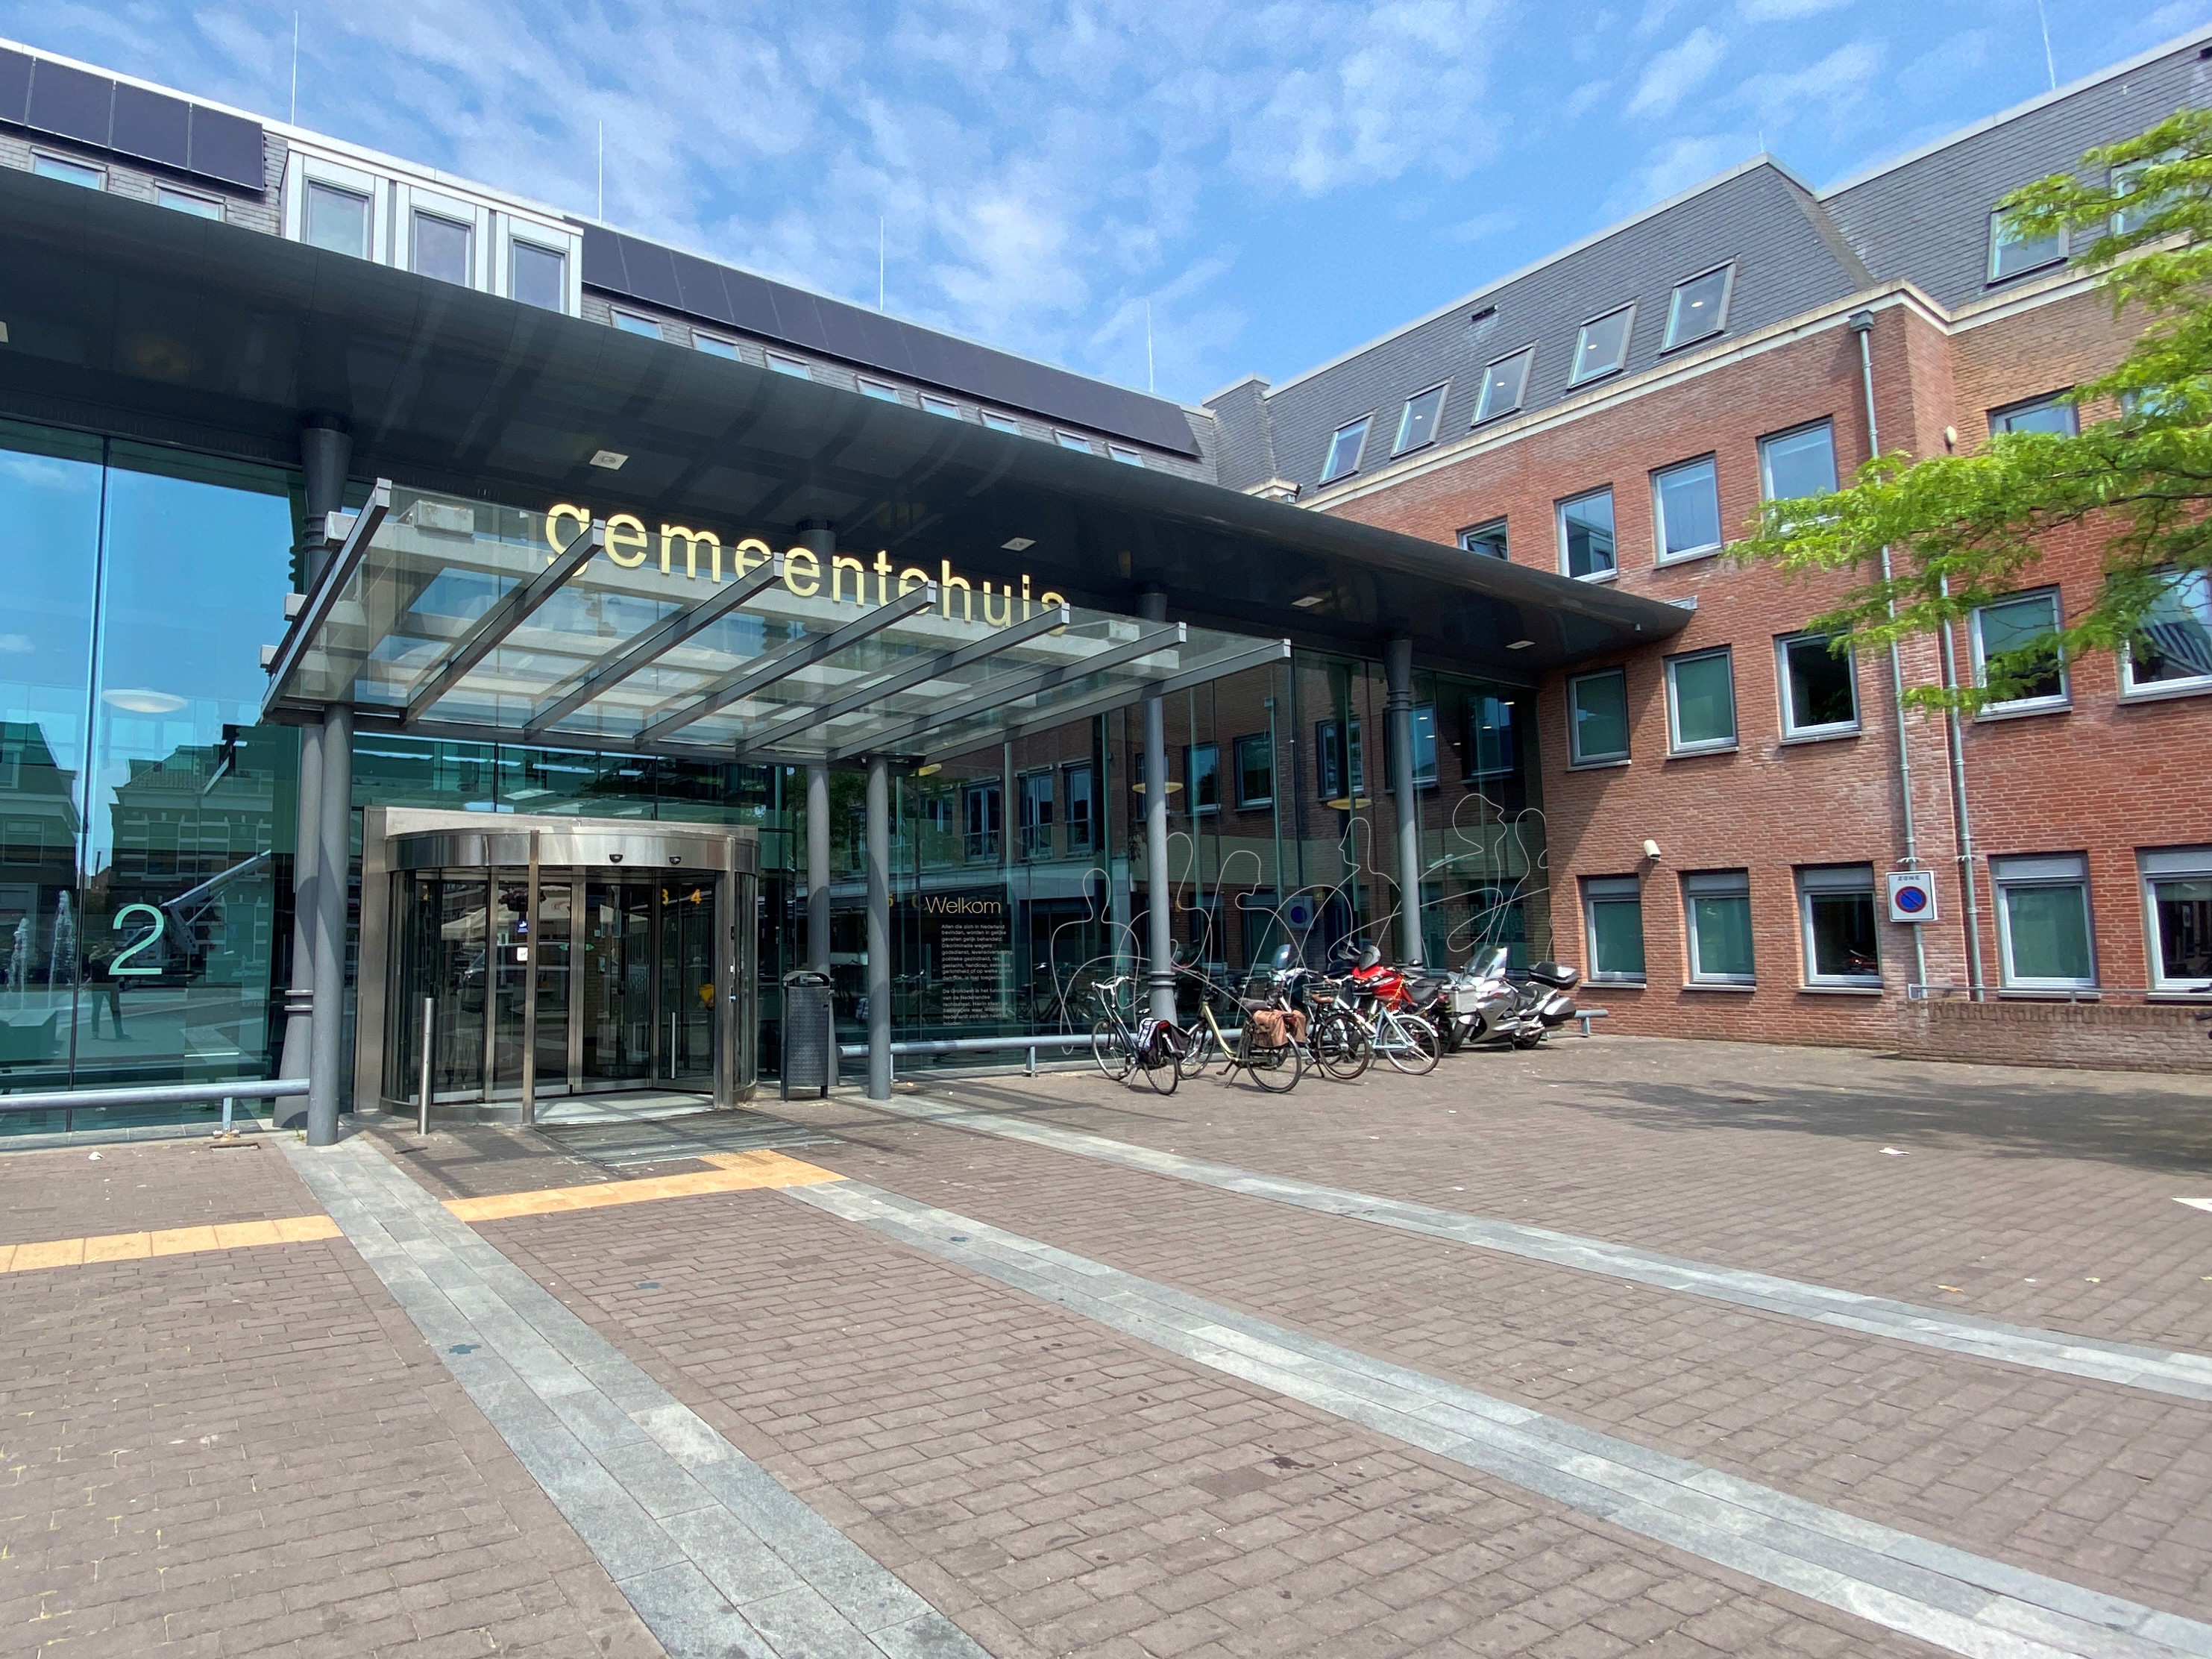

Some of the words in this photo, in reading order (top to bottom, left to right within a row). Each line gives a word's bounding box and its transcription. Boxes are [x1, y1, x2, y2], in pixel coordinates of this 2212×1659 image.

[545, 504, 1066, 636] gemeentehuis
[108, 903, 164, 976] 2
[926, 897, 1000, 913] Welkom
